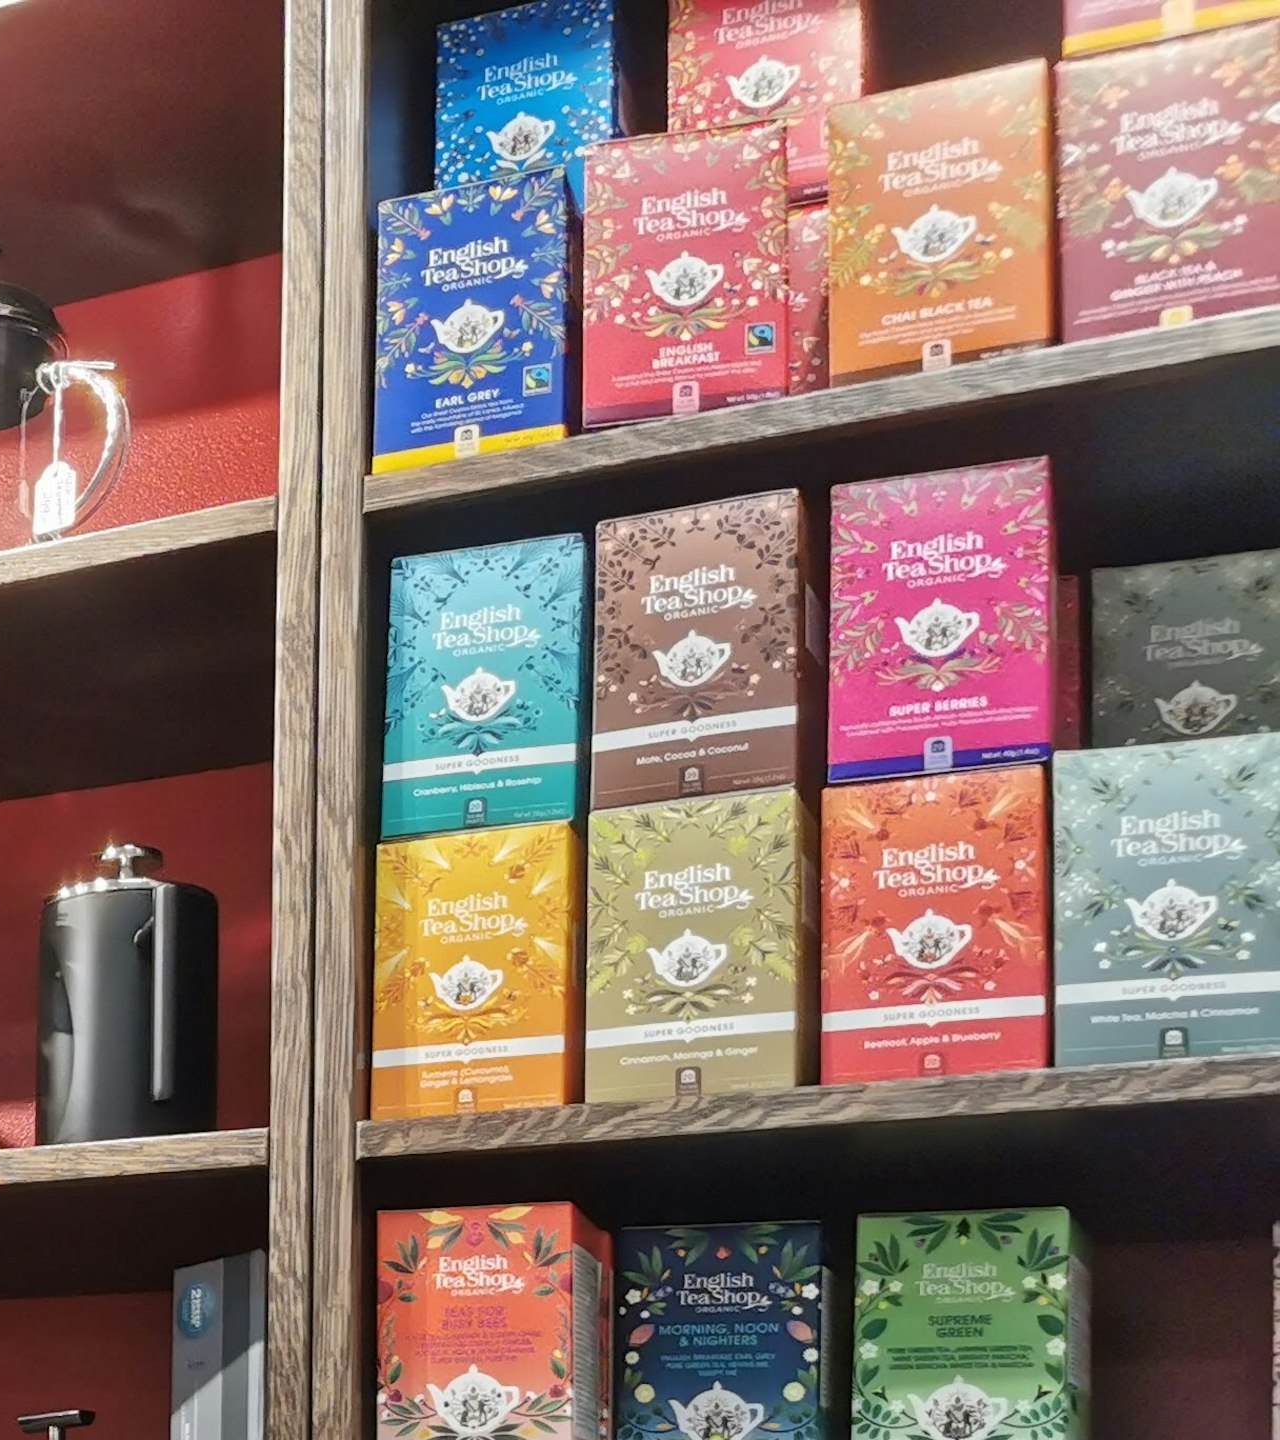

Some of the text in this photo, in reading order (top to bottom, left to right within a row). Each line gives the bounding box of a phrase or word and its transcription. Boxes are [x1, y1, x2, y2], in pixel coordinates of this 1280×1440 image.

[484, 53, 559, 84] English
[476, 67, 564, 101] Tea Shop
[886, 136, 980, 171] English
[878, 158, 988, 192] Tea Shop
[641, 188, 727, 220] English
[633, 204, 737, 235] Tea Shop
[428, 237, 508, 270] English
[420, 252, 517, 287] Tea Shop
[441, 275, 493, 292] ORGANIC
[881, 310, 917, 327] CHAI
[651, 350, 720, 371] BREAKFAST
[659, 342, 714, 358] ENGLISH
[435, 388, 500, 409] EARL GREY
[890, 531, 984, 562] English
[648, 564, 737, 594] English
[641, 584, 743, 614] Tea Shop
[440, 603, 521, 635] English
[432, 623, 529, 651] Tea Shop
[889, 695, 989, 717] SUPER BERRIES
[882, 841, 975, 872] English
[643, 863, 731, 893] English
[427, 891, 508, 922] English
[658, 1322, 780, 1338] MORNING, NOON
[927, 1314, 993, 1327] SUPREME
[935, 1327, 984, 1339] GREEN
[679, 1334, 758, 1348] & NIGHTERS
